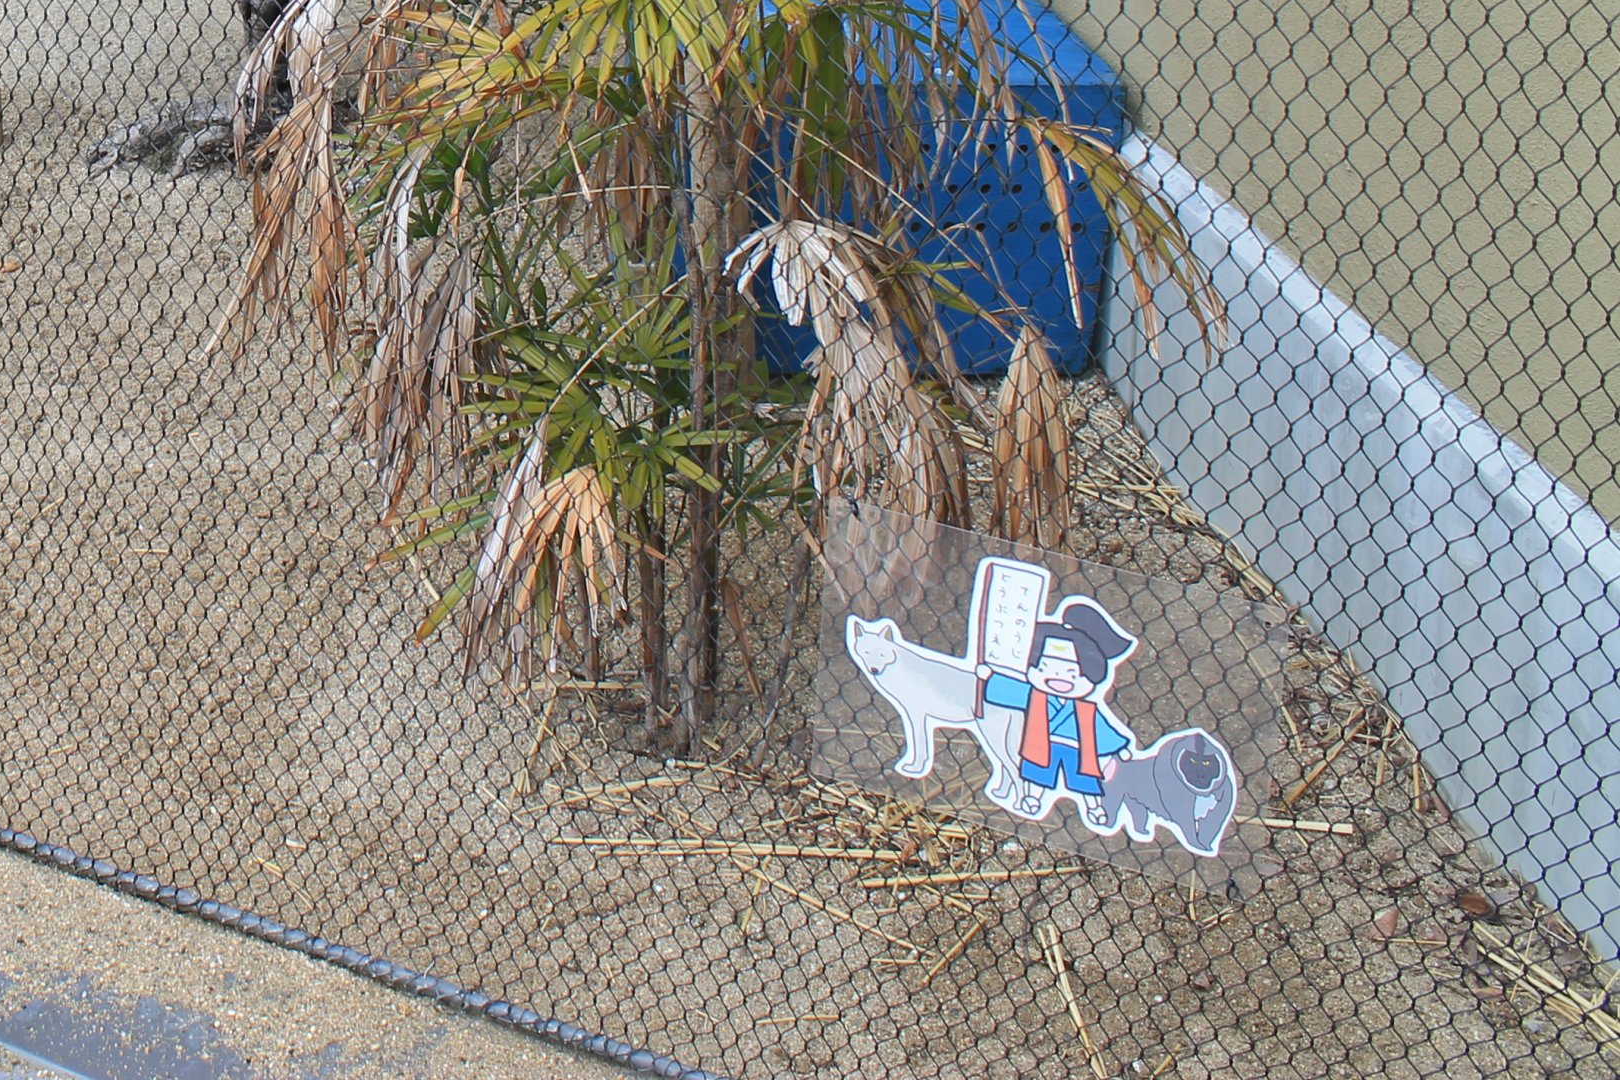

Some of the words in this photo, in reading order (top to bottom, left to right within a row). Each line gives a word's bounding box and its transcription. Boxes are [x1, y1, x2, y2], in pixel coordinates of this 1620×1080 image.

[988, 573, 1012, 661] どうぶつえん
[1011, 585, 1029, 660] てんのうじ
